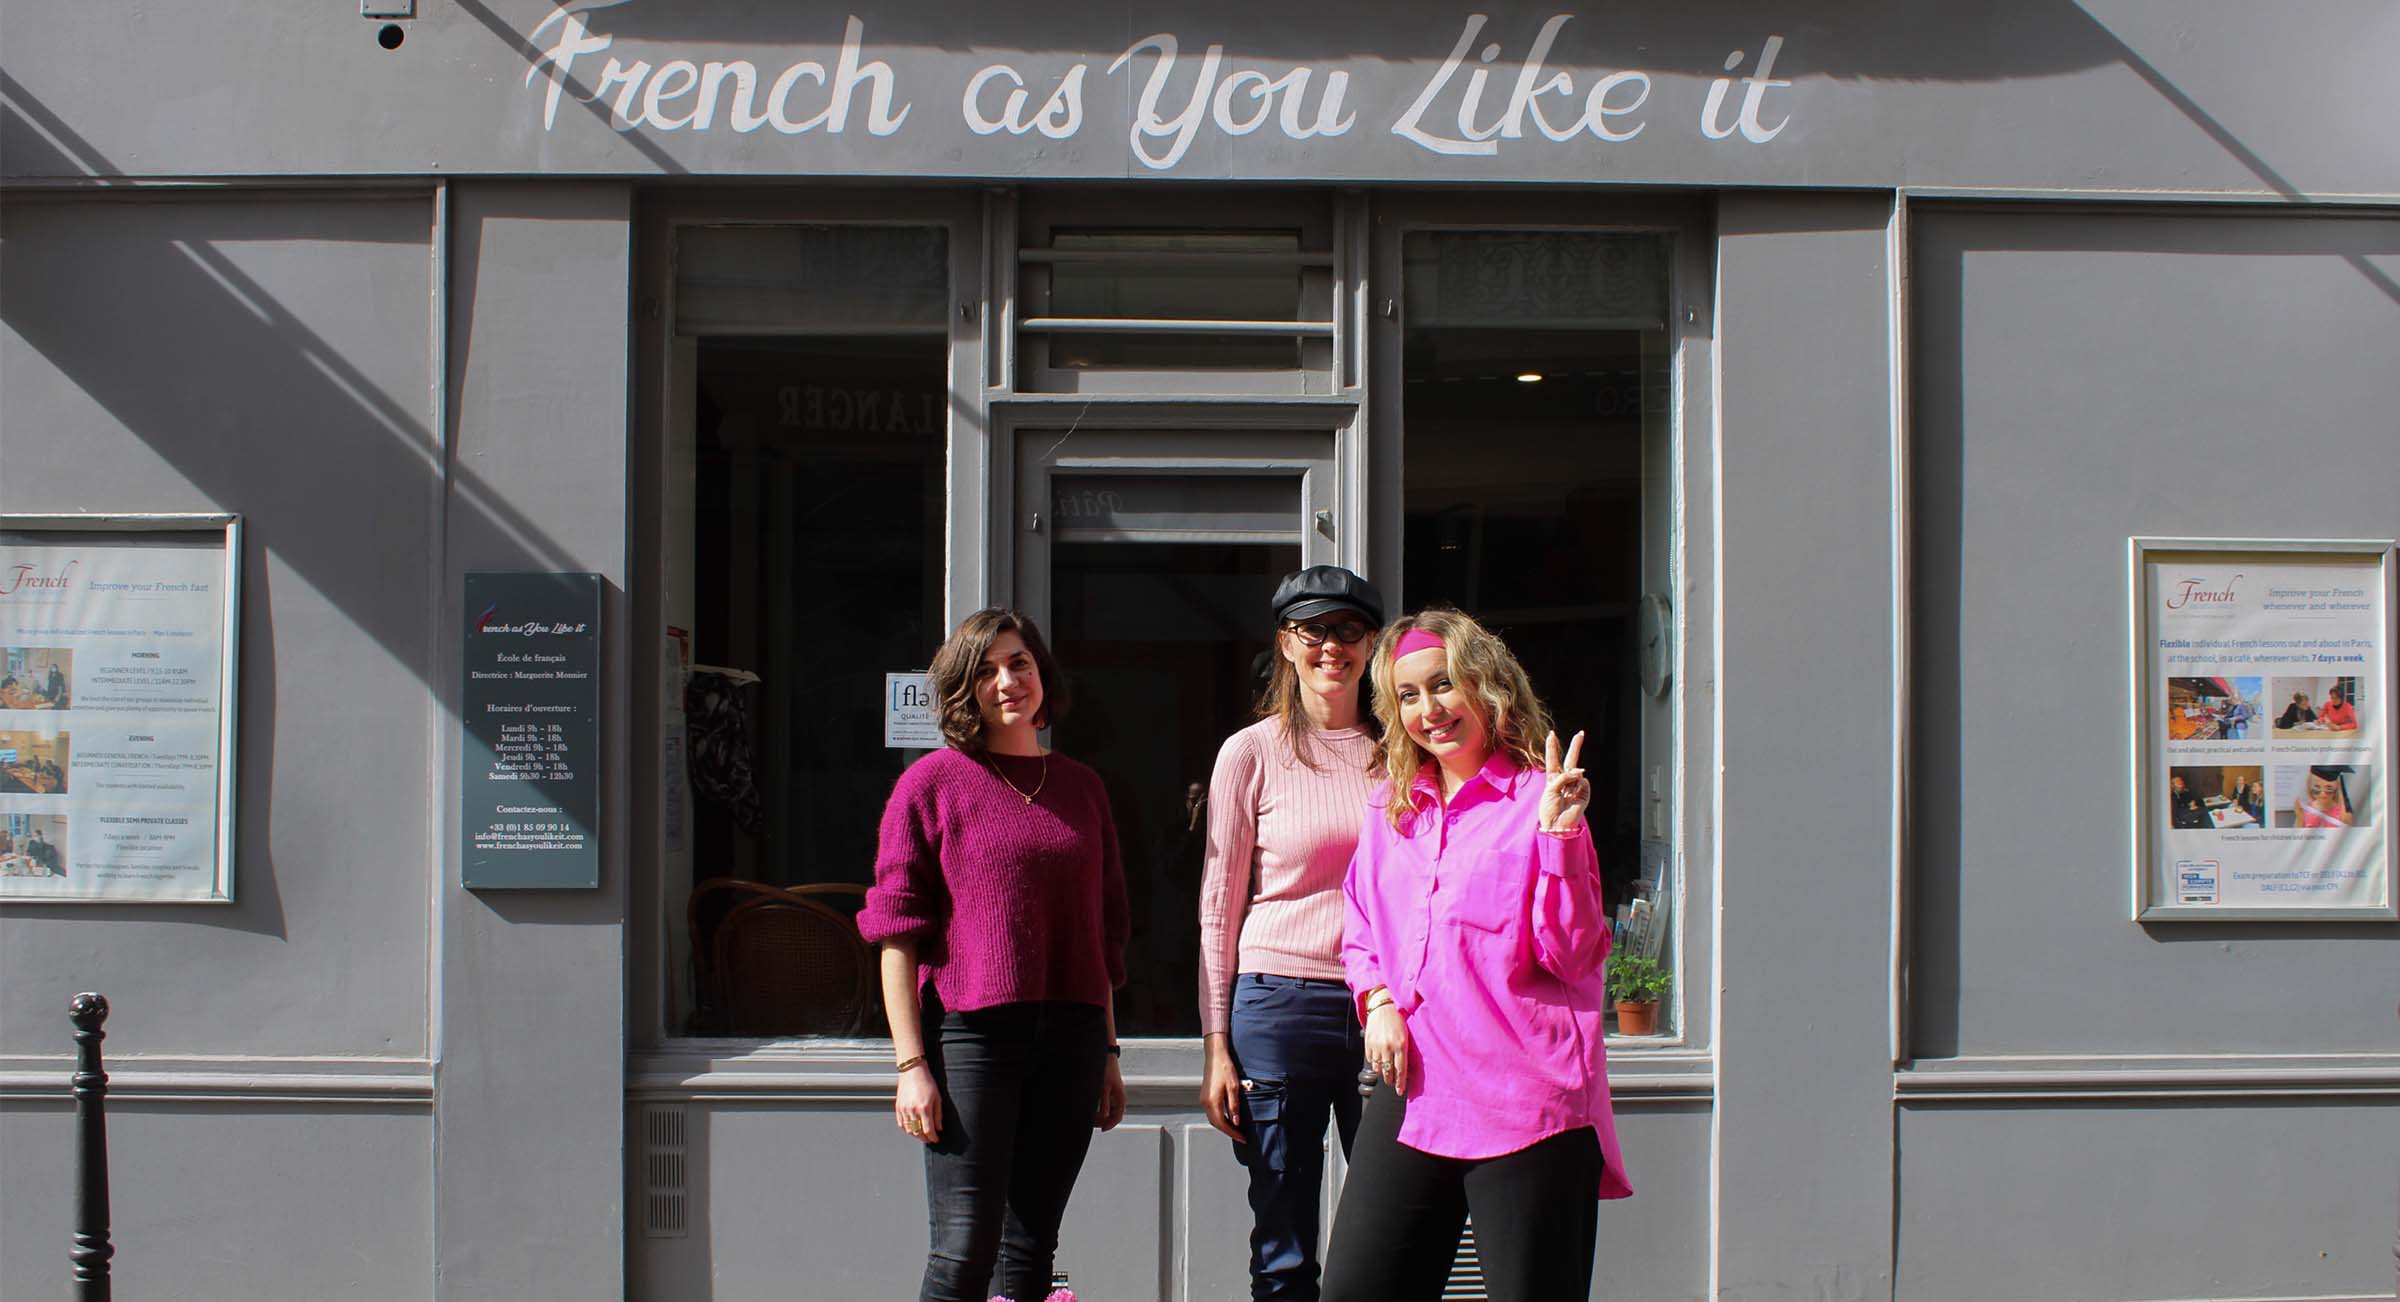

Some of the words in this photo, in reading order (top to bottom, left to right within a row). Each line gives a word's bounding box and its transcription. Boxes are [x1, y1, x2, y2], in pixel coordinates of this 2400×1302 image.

[525, 0, 911, 137] French
[962, 63, 1088, 139] as
[1107, 33, 1356, 169] You
[1391, 14, 1652, 156] Like
[1701, 35, 1792, 143] it
[0, 560, 79, 595] French
[88, 581, 128, 593] Improve
[130, 583, 153, 593] your
[154, 582, 188, 592] French
[190, 582, 209, 592] fast
[2166, 573, 2244, 610] French
[2269, 587, 2307, 598] Improve
[2309, 590, 2331, 599] your
[2332, 587, 2364, 597] French
[2263, 602, 2306, 611] whenever
[2309, 602, 2326, 611] and
[2329, 602, 2370, 611] wherever
[511, 625, 523, 633] as
[523, 622, 549, 637] You
[551, 622, 574, 635] Like
[575, 623, 587, 633] it
[2160, 639, 2191, 648] Flexible
[2192, 639, 2230, 648] individual
[2232, 639, 2258, 648] French
[2259, 639, 2287, 648] lessons
[2288, 639, 2302, 648] out
[2303, 639, 2318, 648] and
[2319, 639, 2340, 648] about
[2342, 639, 2350, 648] in
[497, 652, 520, 662] École
[522, 654, 533, 662] de
[534, 654, 566, 664] français
[2254, 654, 2289, 664] wherever
[2311, 654, 2317, 664] 7
[2318, 654, 2335, 664] days
[472, 671, 508, 679] Directrice
[514, 671, 554, 680] Marguerite
[556, 671, 588, 679] Monnier
[487, 704, 523, 712] Horaires
[524, 704, 572, 712] d'ouverture
[501, 724, 525, 732] Lundi
[527, 724, 537, 732] 9h
[547, 724, 562, 732] 18h
[501, 734, 525, 742] Mardi
[527, 734, 537, 742] 9h
[547, 734, 562, 742] 18h
[501, 753, 523, 761] Jeudi
[525, 753, 535, 761] 9h
[545, 753, 560, 761] 18h
[488, 772, 518, 780] Samedi
[520, 772, 540, 780] 9h30
[549, 772, 573, 780] 12h30
[496, 805, 557, 813] Contactez-nous
[489, 824, 504, 832] +33
[506, 824, 520, 832] (0)1
[523, 824, 534, 832] 85
[536, 824, 545, 832] 09
[547, 824, 558, 832] 90
[560, 824, 569, 832] 14
[475, 833, 584, 841] info@frenchasyoulikeit.com
[476, 842, 582, 850] www.frenchasyoulikeit.com
